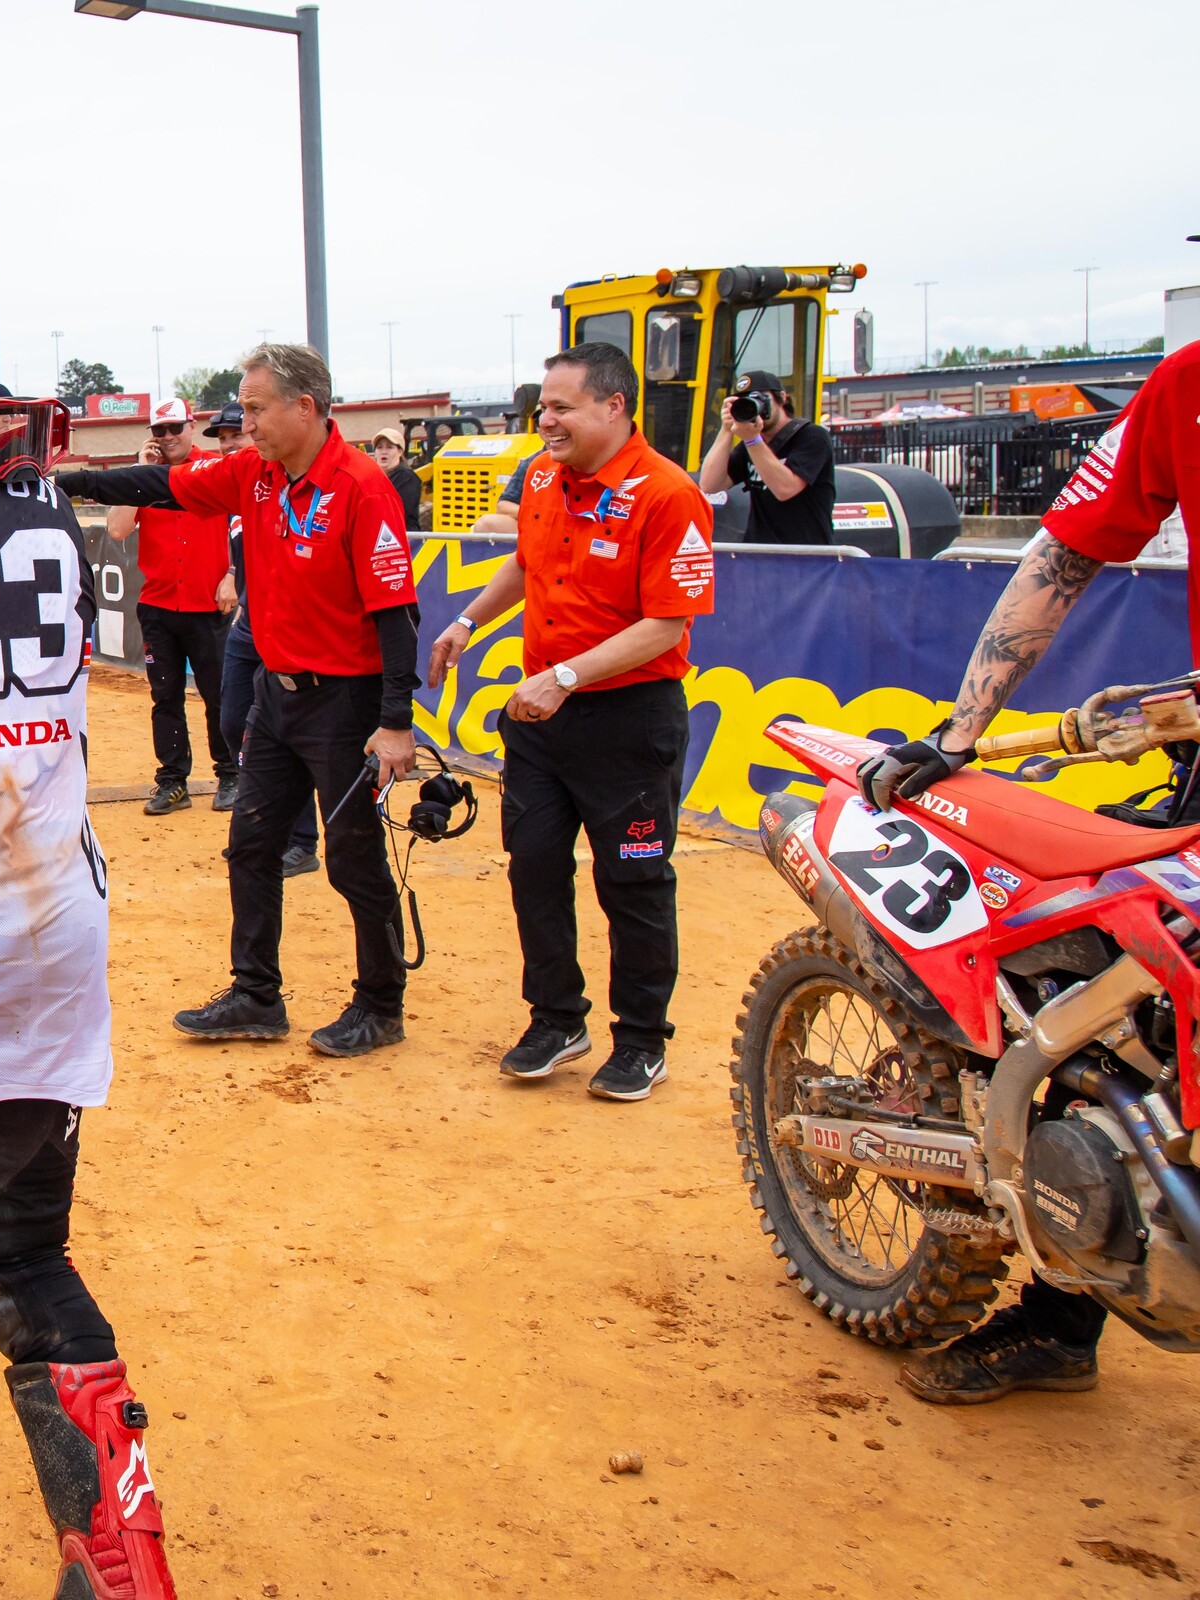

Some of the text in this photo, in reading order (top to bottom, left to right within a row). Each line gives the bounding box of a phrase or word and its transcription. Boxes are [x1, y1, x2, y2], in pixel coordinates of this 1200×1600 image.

[796, 737, 856, 767] DUNLOP
[910, 791, 969, 827] NDA
[620, 840, 663, 859] HRC
[828, 819, 971, 934] 23
[851, 1127, 964, 1168] RENTHAL
[1034, 1179, 1082, 1215] HONDA
